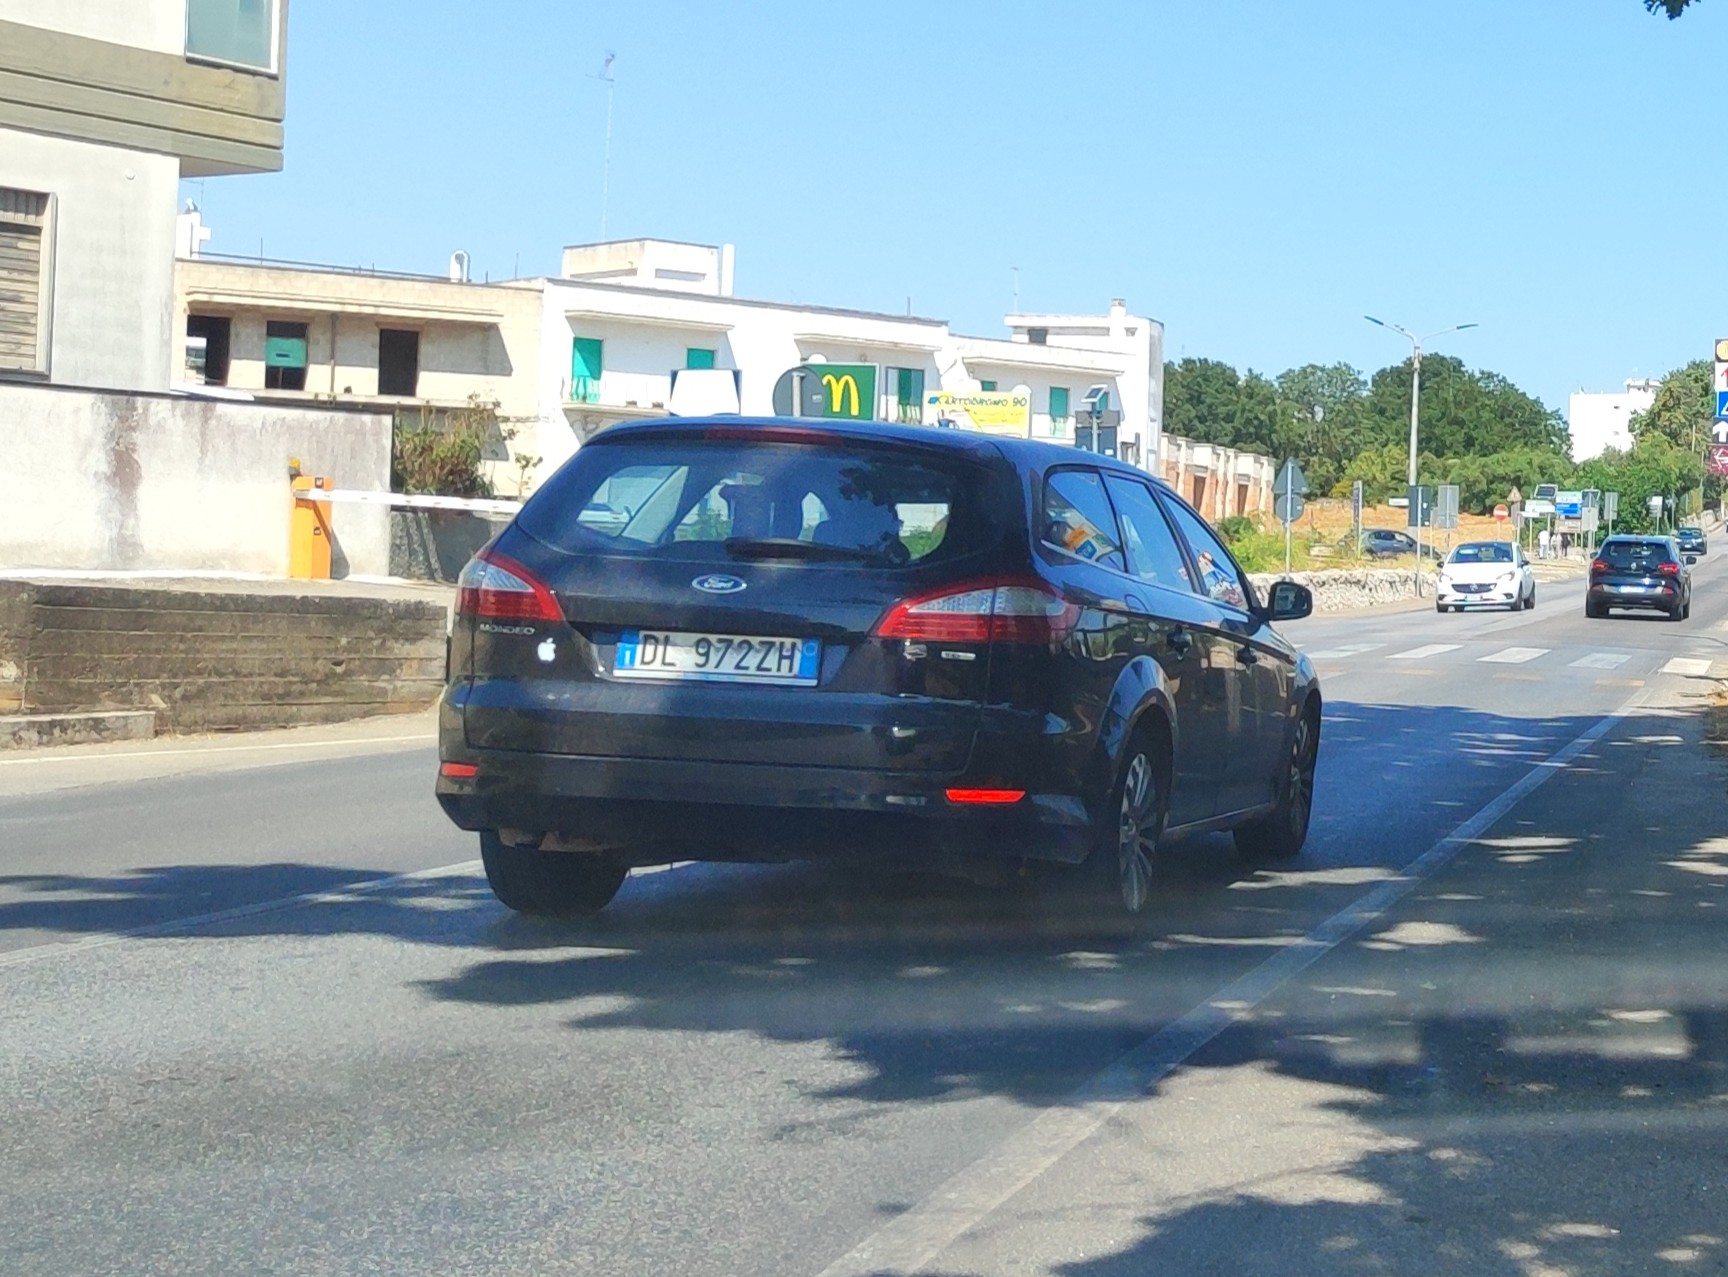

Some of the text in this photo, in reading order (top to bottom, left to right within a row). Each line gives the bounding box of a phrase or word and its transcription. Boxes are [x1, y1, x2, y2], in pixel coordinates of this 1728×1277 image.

[479, 623, 536, 635] MONDEO
[640, 634, 676, 668] DL
[694, 637, 797, 673] 972ZH
